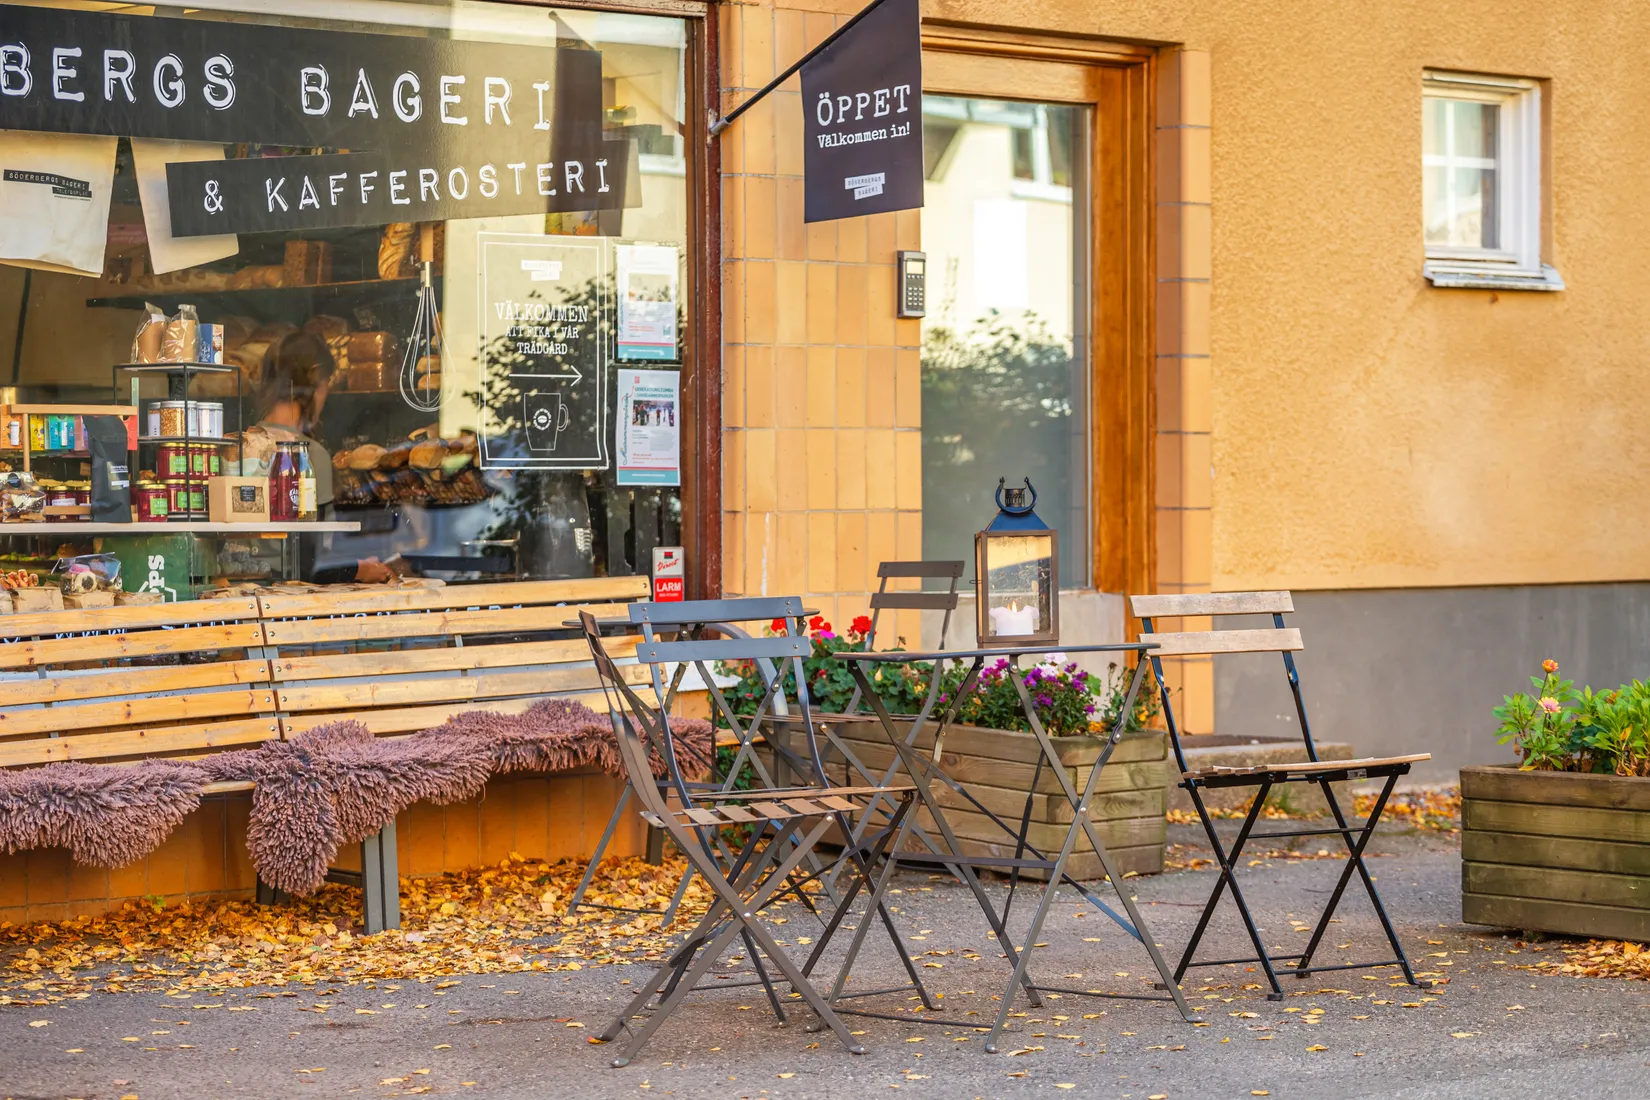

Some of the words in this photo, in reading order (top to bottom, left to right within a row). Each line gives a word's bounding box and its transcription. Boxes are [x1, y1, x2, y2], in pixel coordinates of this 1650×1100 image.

[0, 41, 235, 110] BERGS
[300, 64, 551, 131] BAGERI
[817, 85, 910, 126] ÖPPET
[817, 129, 887, 148] Välkommen
[890, 122, 910, 138] in!
[9, 172, 58, 183] SÖDERBERGS
[62, 180, 86, 190] BAGERI
[203, 179, 224, 215] &
[266, 158, 610, 213] KAFFEROSTERI
[494, 300, 589, 322] VÄLKOMMEN
[505, 325, 524, 337] ATT
[526, 325, 550, 338] FIKA
[553, 326, 559, 338] I
[561, 325, 579, 338] VÅR
[517, 341, 568, 355] TRÄDGÅRD
[657, 582, 681, 592] LARM
